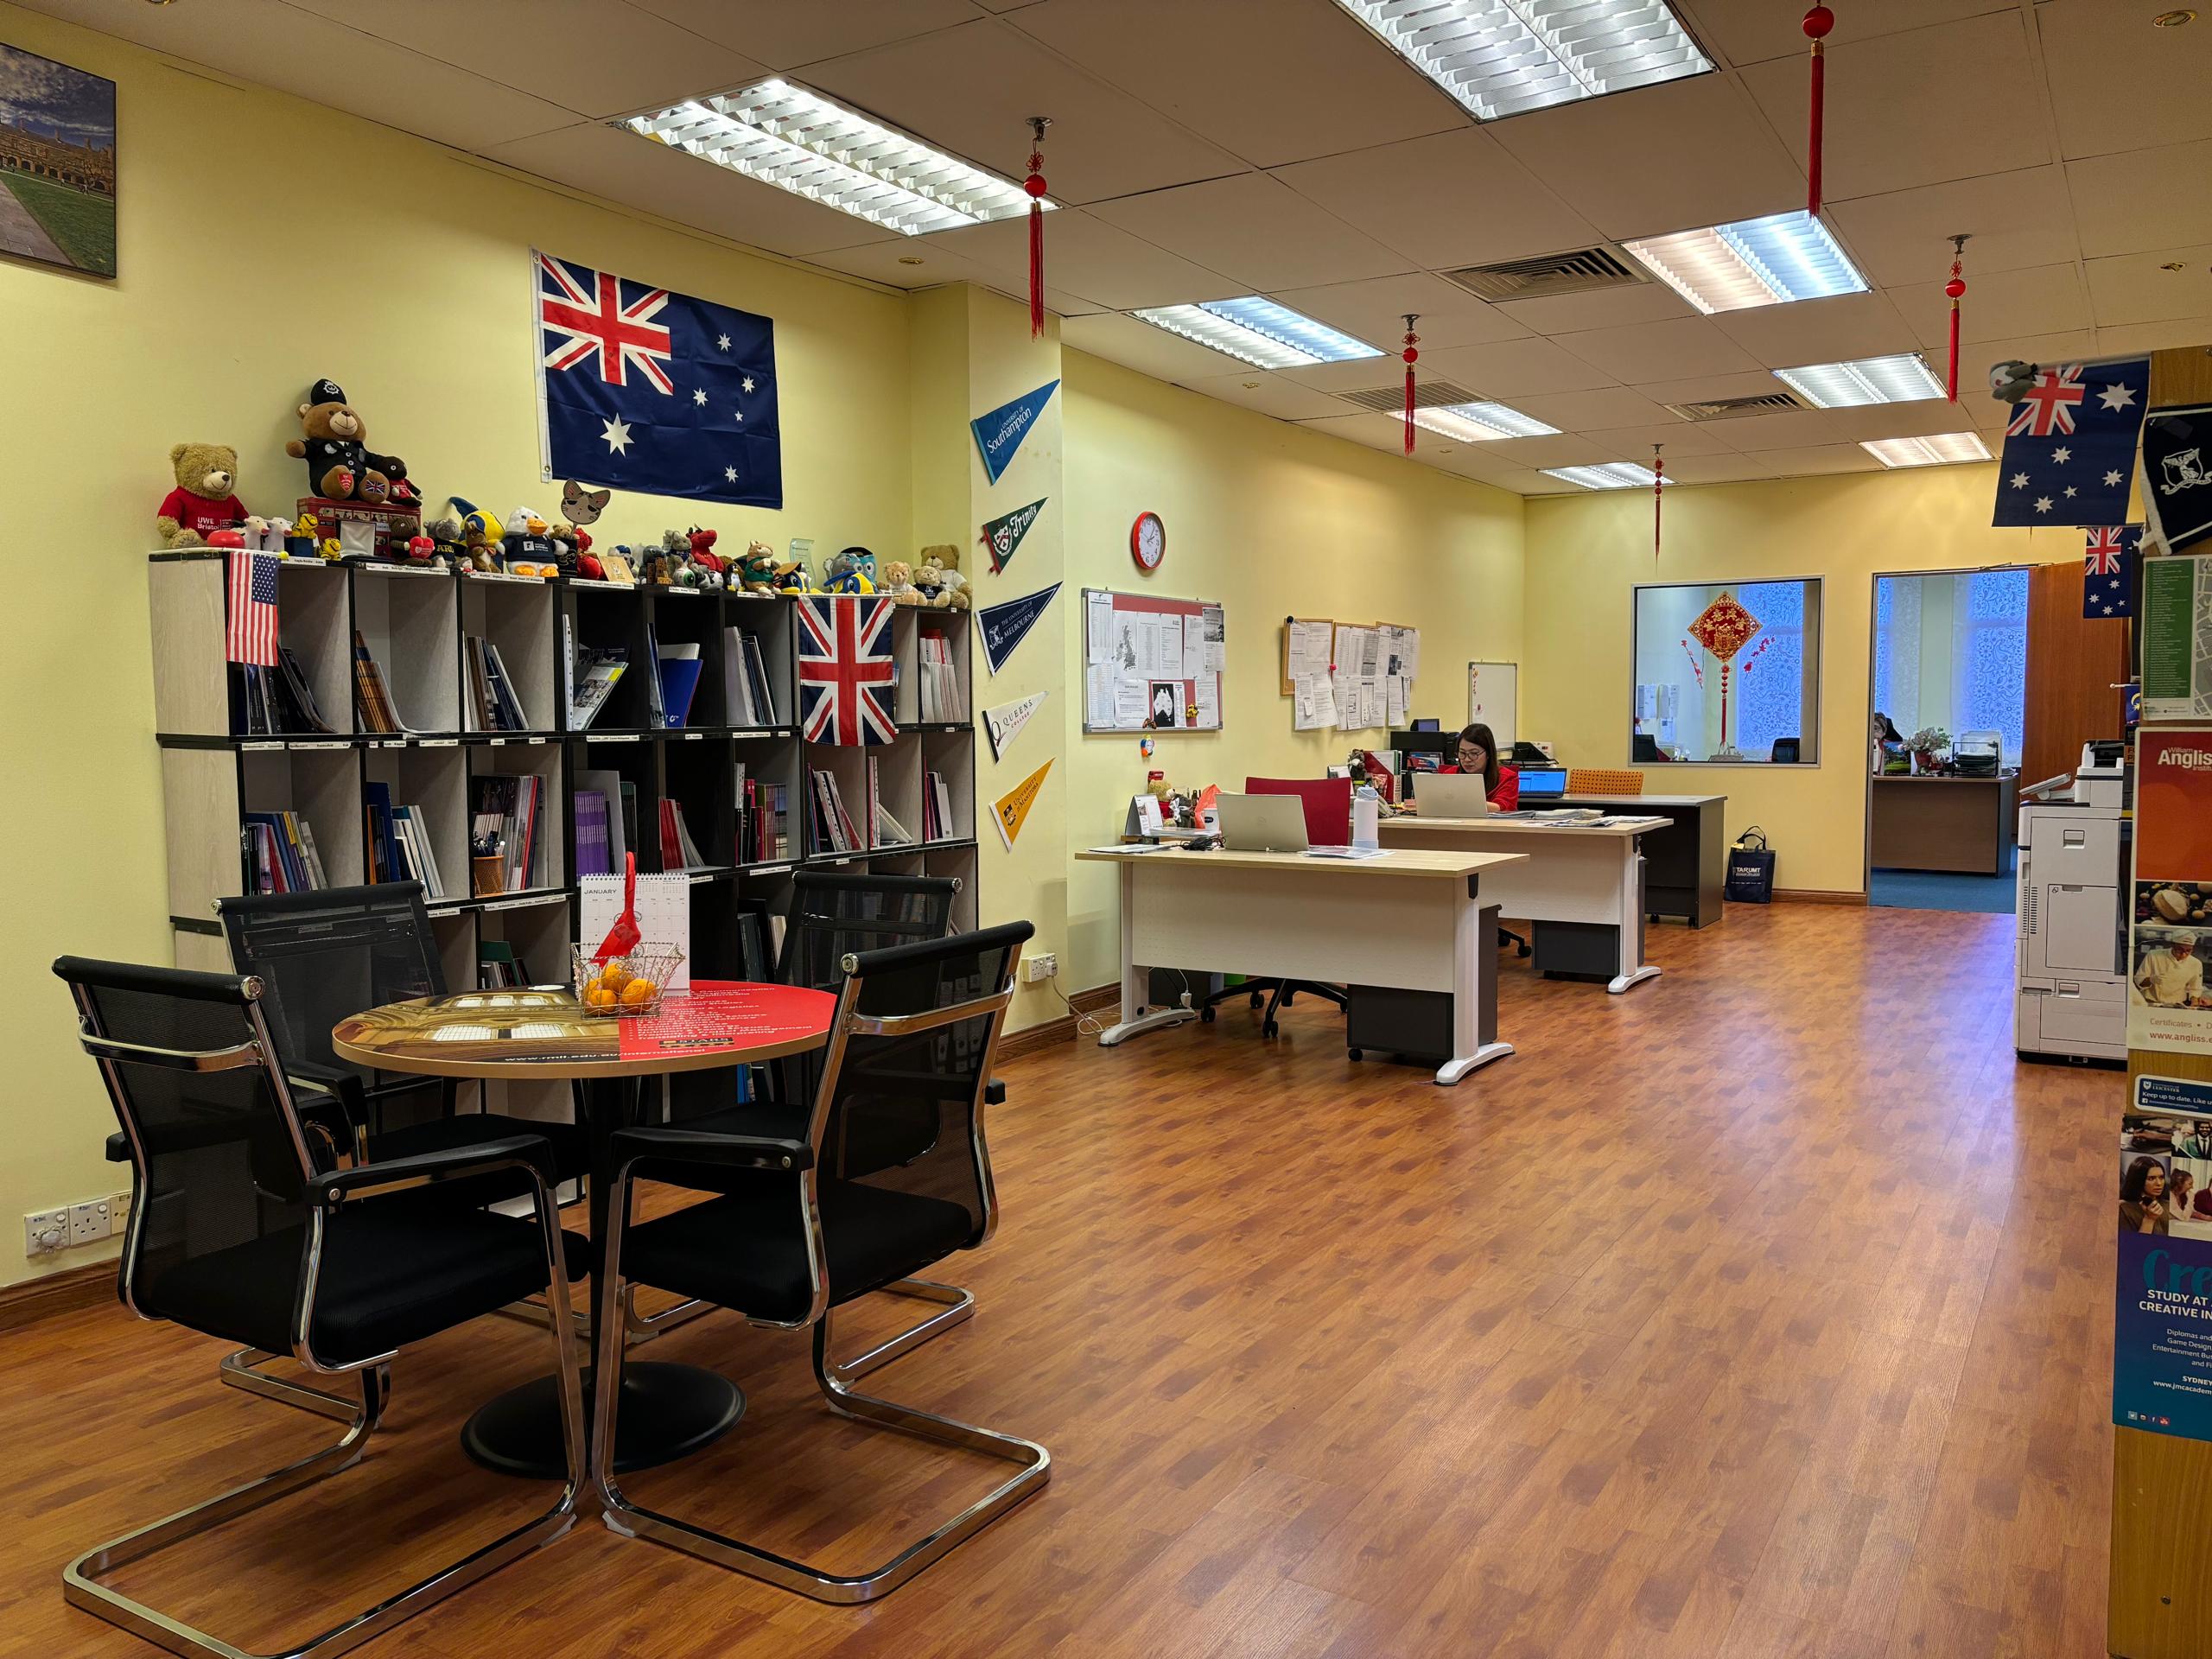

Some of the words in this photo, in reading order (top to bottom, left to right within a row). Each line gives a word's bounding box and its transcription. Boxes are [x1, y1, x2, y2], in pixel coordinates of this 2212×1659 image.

[987, 408, 1032, 453] Southampton
[1010, 505, 1037, 537] Trinity
[1004, 610, 1035, 638] MELBOURNE
[1003, 699, 1033, 726] QUEENS
[2158, 749, 2212, 769] Anglis
[2150, 1018, 2192, 1028] Certificates
[505, 1049, 705, 1061] www.rmit.edu.au/international
[2147, 1289, 2190, 1303] STUDY
[2192, 1296, 2208, 1306] AT
[2139, 1301, 2198, 1318] CREATIVE
[2167, 1328, 2198, 1339] Diplomas
[2167, 1337, 2187, 1346] Game
[2152, 1343, 2200, 1357] Entertainment
[2182, 1376, 2212, 1386] SYDNEY
